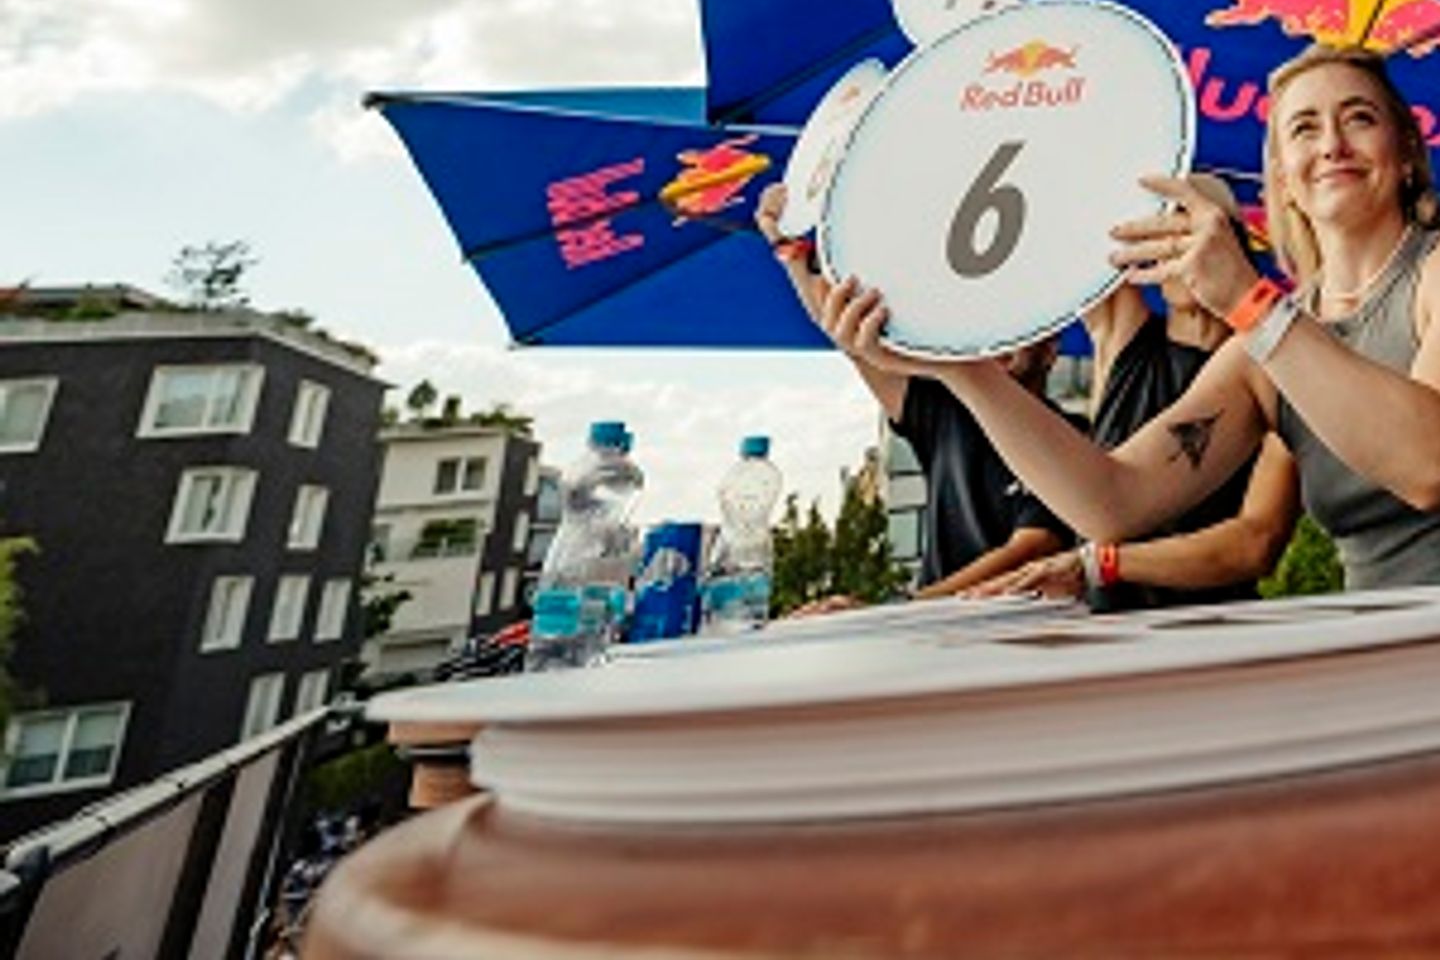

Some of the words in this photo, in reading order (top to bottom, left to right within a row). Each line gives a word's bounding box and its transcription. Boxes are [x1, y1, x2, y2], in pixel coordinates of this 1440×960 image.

[960, 81, 1023, 112] Red
[1023, 77, 1085, 107] Bull
[945, 140, 1028, 278] 6
